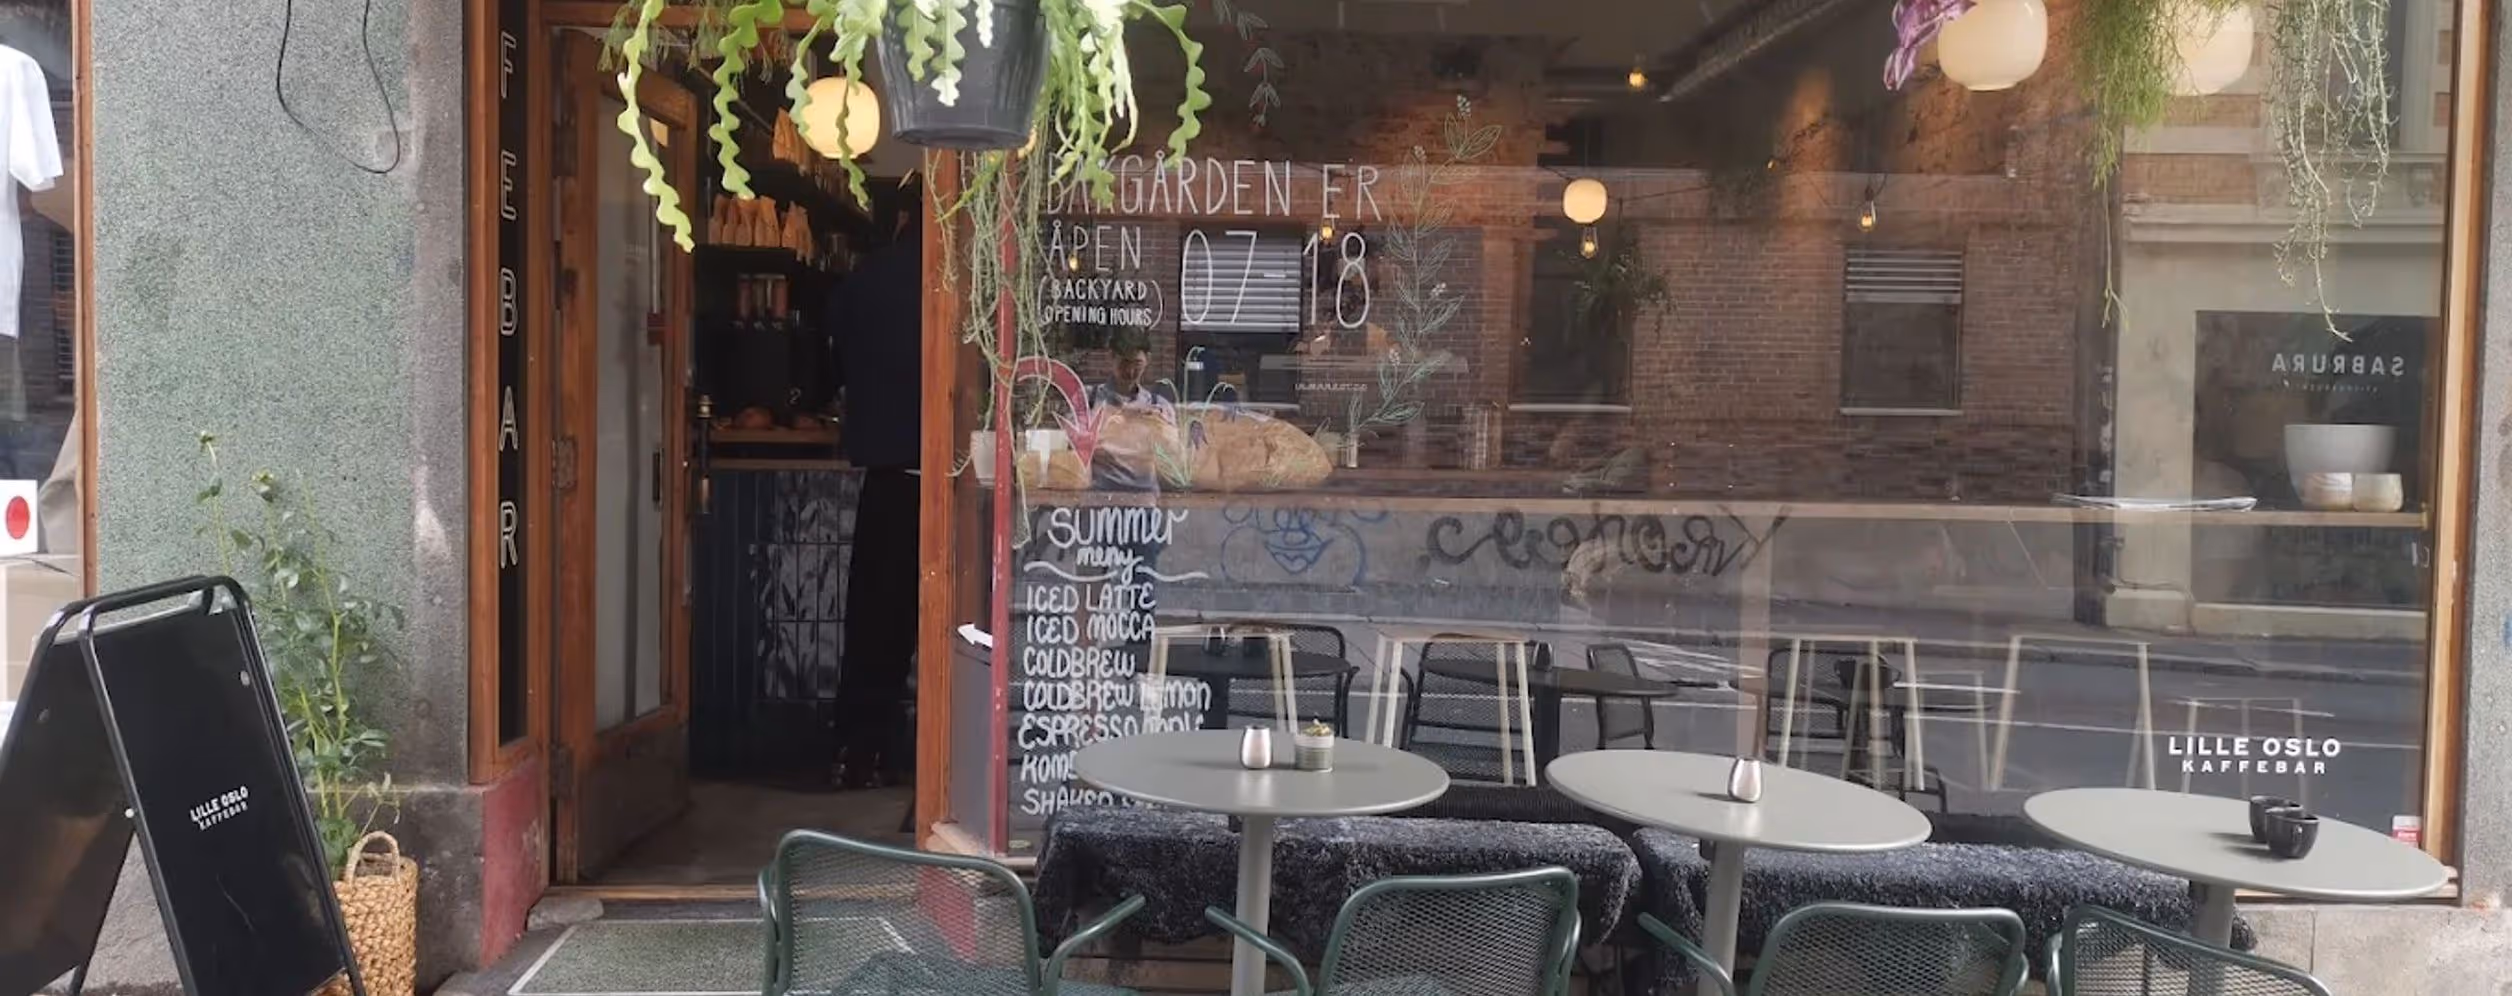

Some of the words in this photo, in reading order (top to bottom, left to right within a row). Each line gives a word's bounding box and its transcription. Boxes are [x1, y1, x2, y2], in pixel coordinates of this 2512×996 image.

[1322, 163, 1382, 221] ER
[1049, 220, 1142, 273] ÅPEN
[1044, 305, 1106, 326] OPENING
[1027, 585, 1079, 613] ICED
[1086, 583, 1156, 612] LATTE
[1027, 615, 1079, 644] ICED
[1087, 611, 1155, 641] MOCCA
[1024, 646, 1135, 679] COLDBREW
[1024, 680, 1134, 712] COLDBREW
[1018, 713, 1138, 749] ESPRESSO
[2169, 736, 2249, 756] LILLE
[2262, 737, 2341, 757] OSLO
[2182, 760, 2326, 774] KAFFEBAR
[190, 797, 220, 822] LILLE
[221, 785, 249, 807] OSLO
